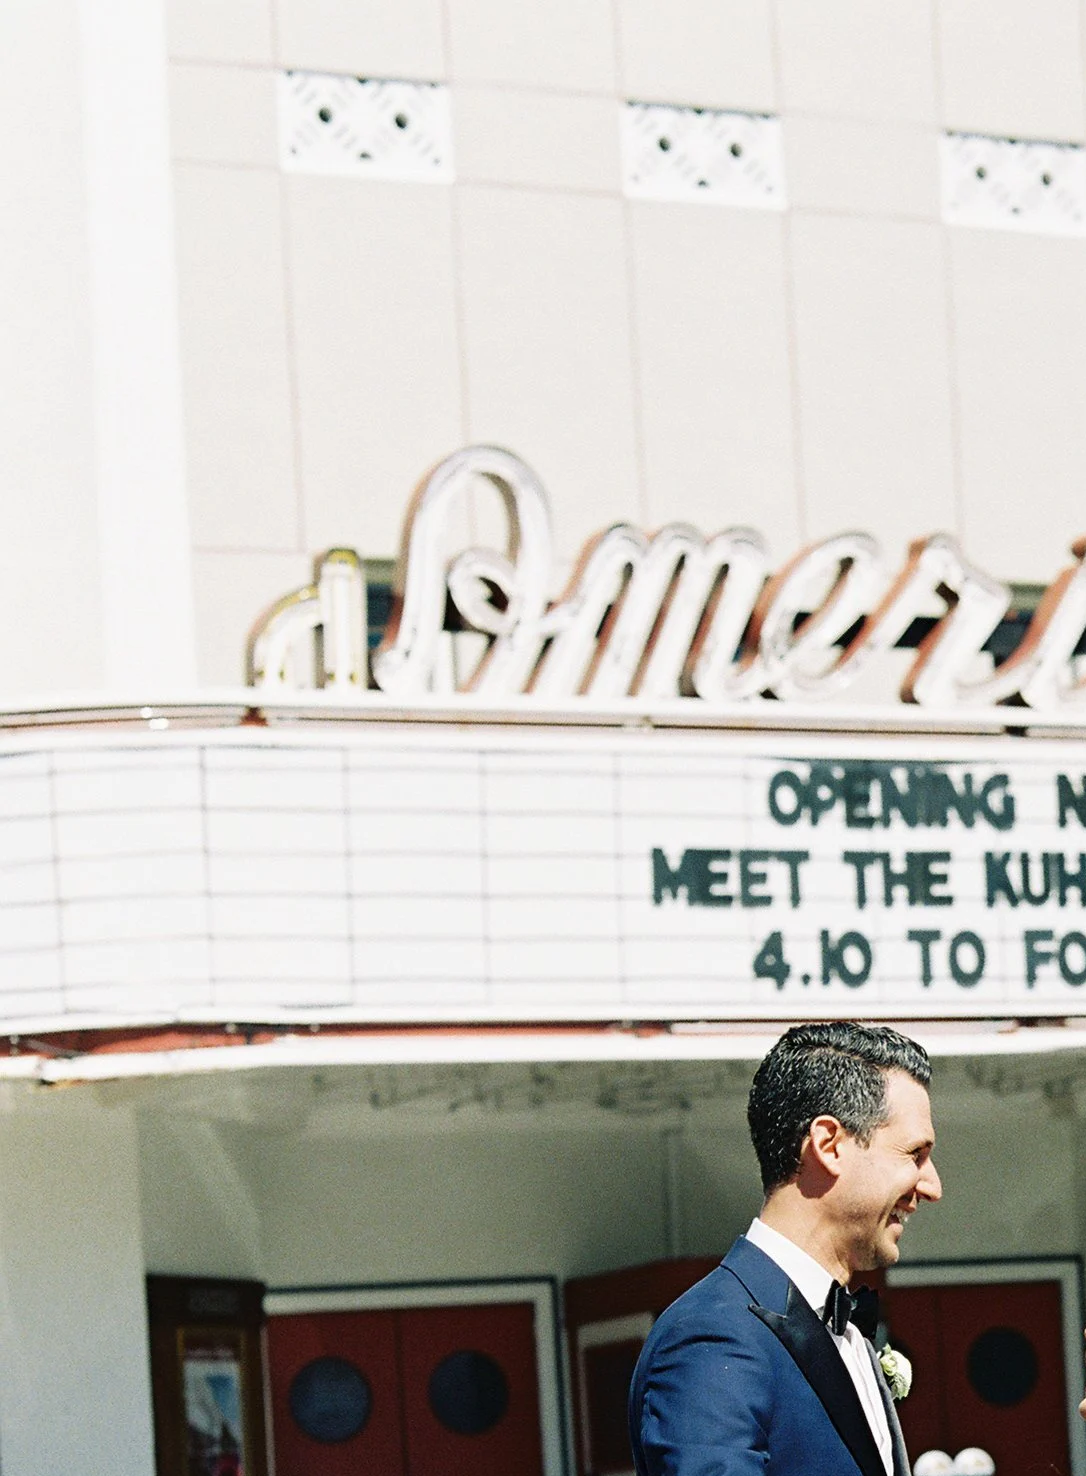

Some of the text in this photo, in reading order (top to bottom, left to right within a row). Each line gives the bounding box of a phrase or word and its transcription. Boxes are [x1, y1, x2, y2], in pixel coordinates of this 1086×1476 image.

[768, 769, 1015, 830] OPENING
[651, 847, 809, 908] MEET
[842, 850, 954, 909] THE
[752, 930, 872, 990] 4.10
[907, 928, 986, 988] TO
